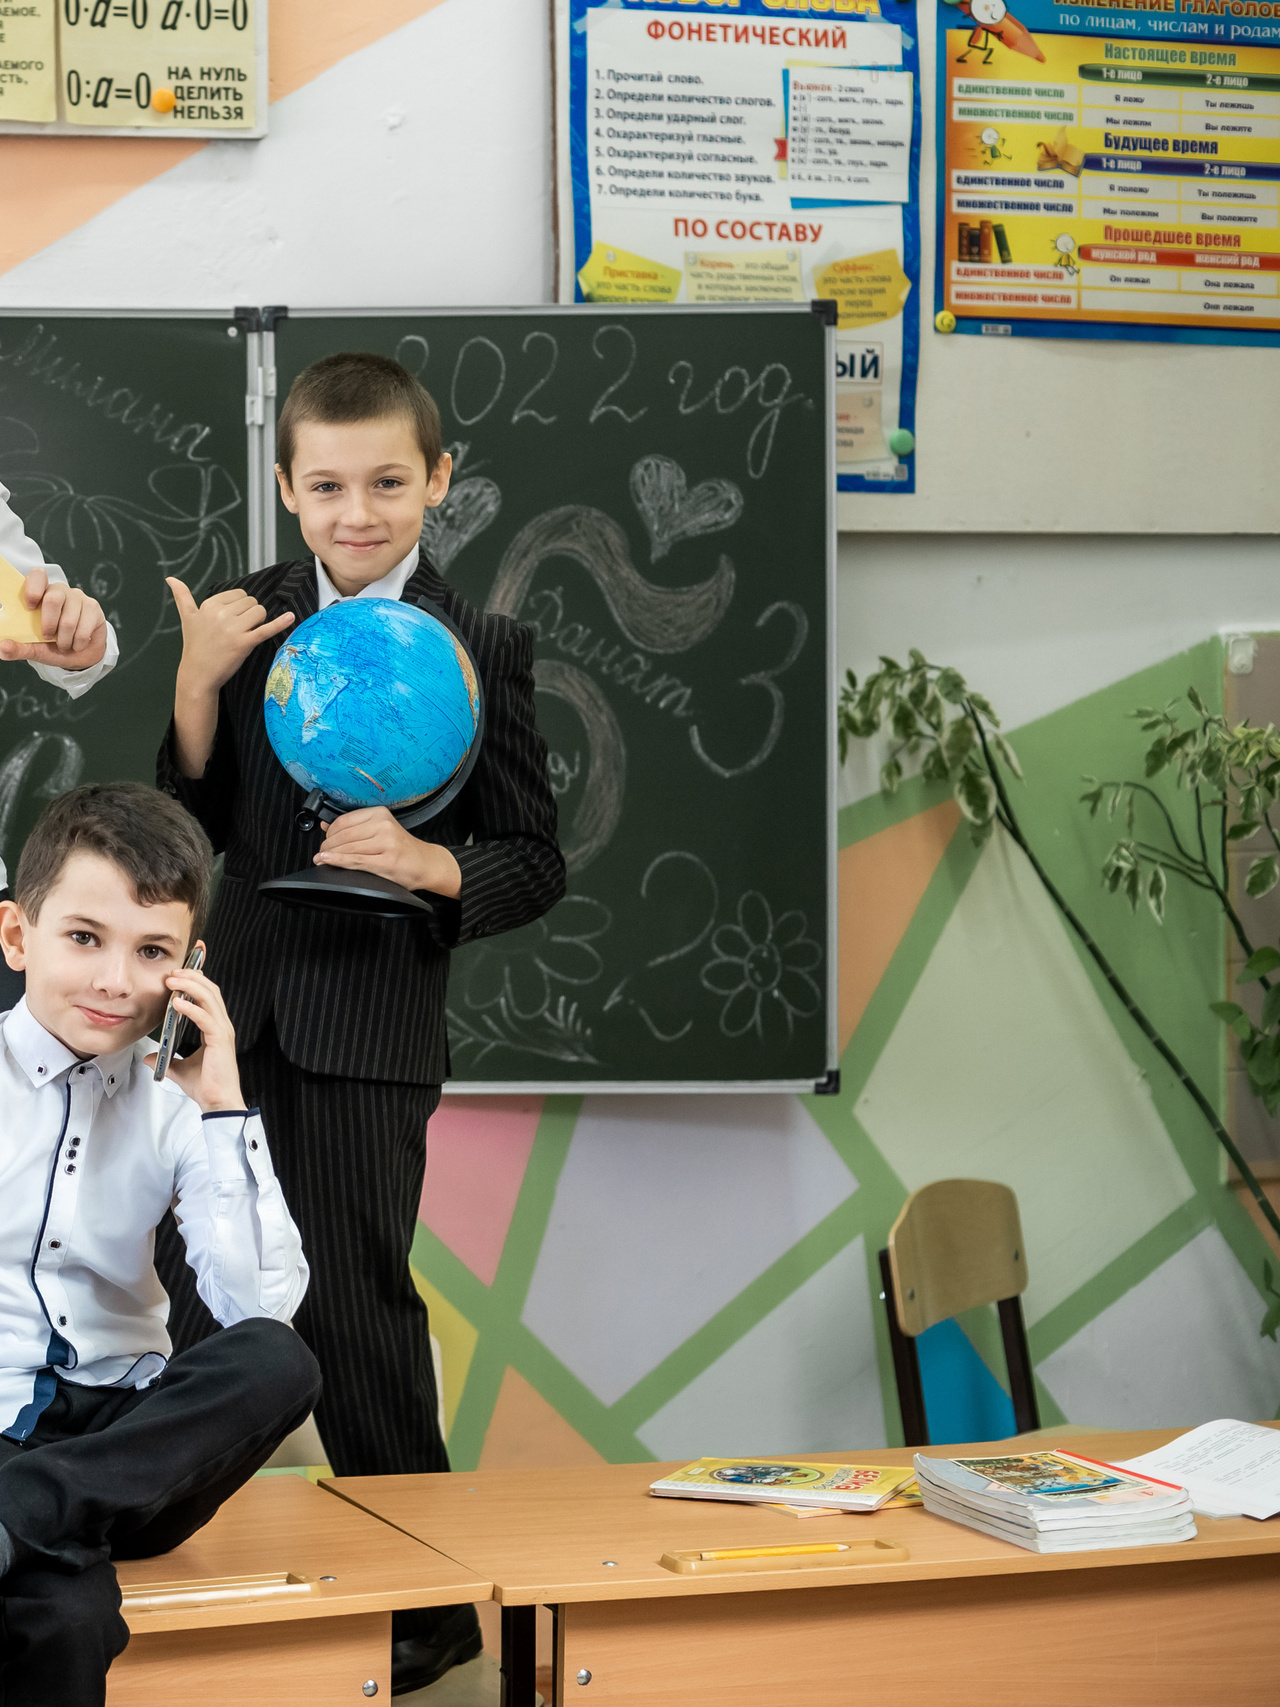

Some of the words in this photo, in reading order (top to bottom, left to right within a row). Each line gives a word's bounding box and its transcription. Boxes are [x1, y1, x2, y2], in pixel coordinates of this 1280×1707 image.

[1060, 13, 1080, 25] по
[1085, 15, 1141, 31] лицам,
[1148, 20, 1209, 34] числам
[1215, 23, 1225, 35] и
[647, 19, 847, 48] ФОНЕТИЧЕСКИЙ
[1104, 43, 1187, 64] Настоящее
[1190, 51, 1237, 66] время
[167, 66, 192, 81] НА
[200, 67, 247, 82] НУЛЬ
[607, 69, 663, 83] Прочитай
[668, 74, 704, 84] слово.
[174, 85, 243, 101] ДЕЛИТЬ
[607, 88, 663, 103] Определи
[667, 94, 732, 105] количество
[1205, 99, 1217, 109] Ты
[173, 105, 244, 120] НЕЛЬЗЯ
[607, 108, 663, 123] Определи
[667, 112, 716, 125] ударный
[1205, 123, 1218, 132] Вы
[607, 128, 693, 144] Охарактеризуй
[1104, 132, 1169, 153] Будущее
[1172, 138, 1218, 154] время
[607, 147, 694, 163] Охарактеризуй
[608, 166, 665, 180] Определи
[668, 171, 731, 182] количество
[609, 184, 665, 199] Определи
[669, 189, 732, 200] количество
[1198, 189, 1209, 198] Ты
[1201, 213, 1214, 222] Вы
[674, 217, 708, 238] ПО
[715, 219, 823, 243] СОСТАВУ
[1104, 225, 1192, 245] Прошедшее
[1196, 232, 1241, 247] время
